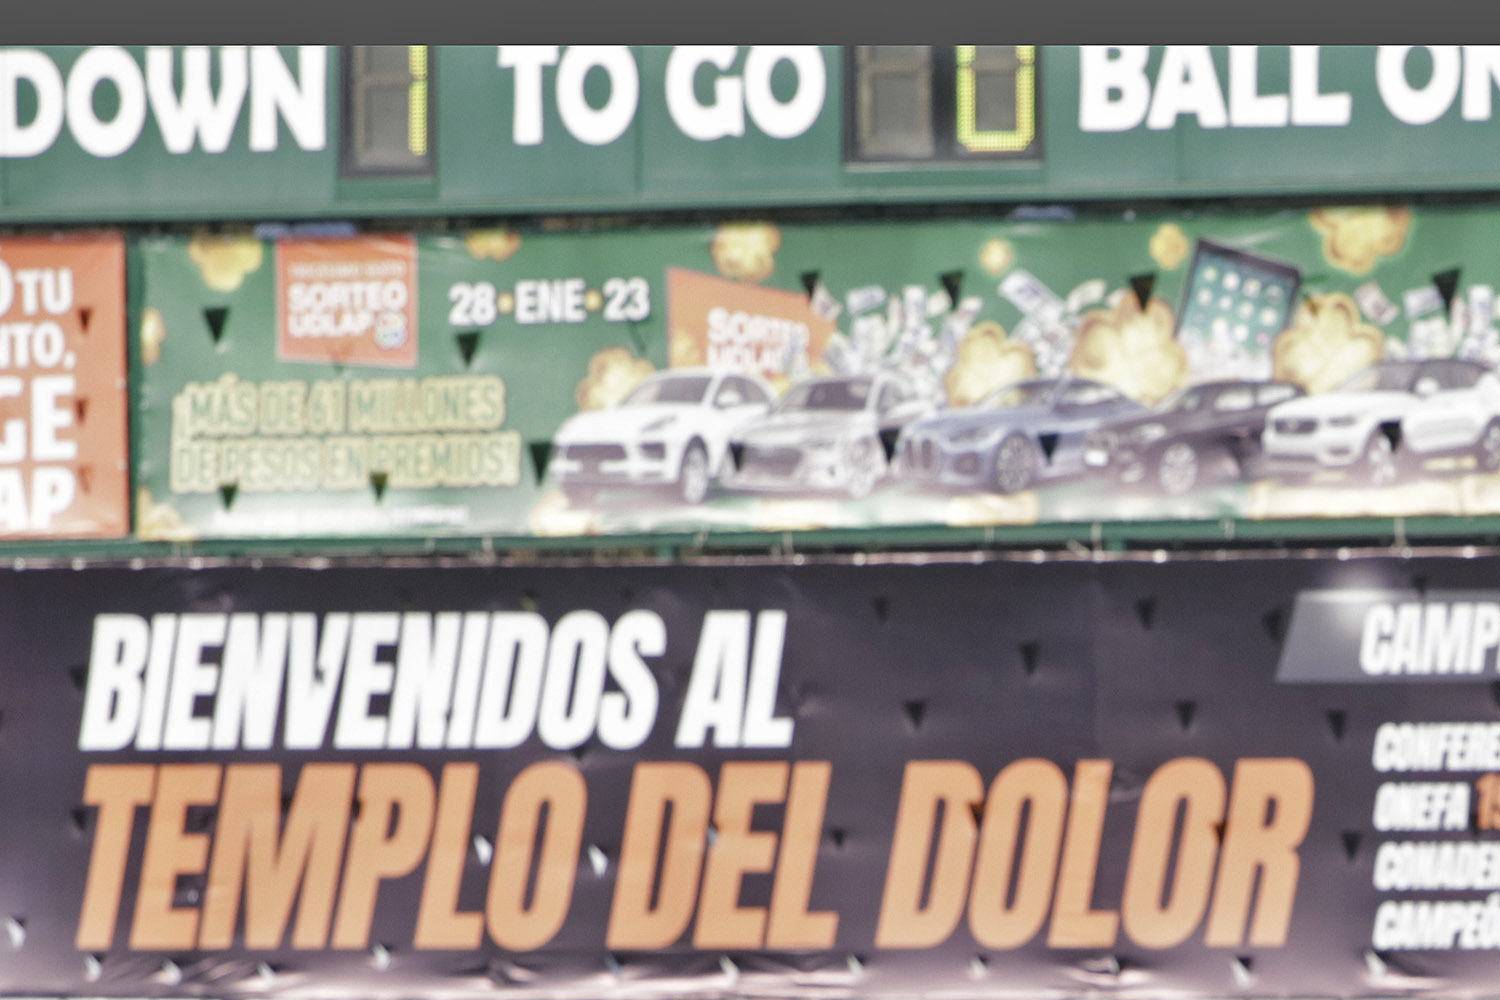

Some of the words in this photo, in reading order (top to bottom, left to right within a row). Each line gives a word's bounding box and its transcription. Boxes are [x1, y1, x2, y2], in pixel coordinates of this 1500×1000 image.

[0, 46, 327, 157] DOWN
[498, 46, 639, 147] TO
[664, 46, 826, 141] GO
[1079, 46, 1351, 133] BALL
[17, 267, 74, 316] TU
[448, 281, 497, 327] 28
[515, 279, 587, 324] ENE
[604, 276, 650, 321] 23
[79, 610, 667, 751] BIENVENIDOS
[675, 610, 795, 748] AL
[75, 760, 588, 952] TEMPLO
[606, 760, 840, 950] DEL
[874, 757, 1316, 949] DOLOR
